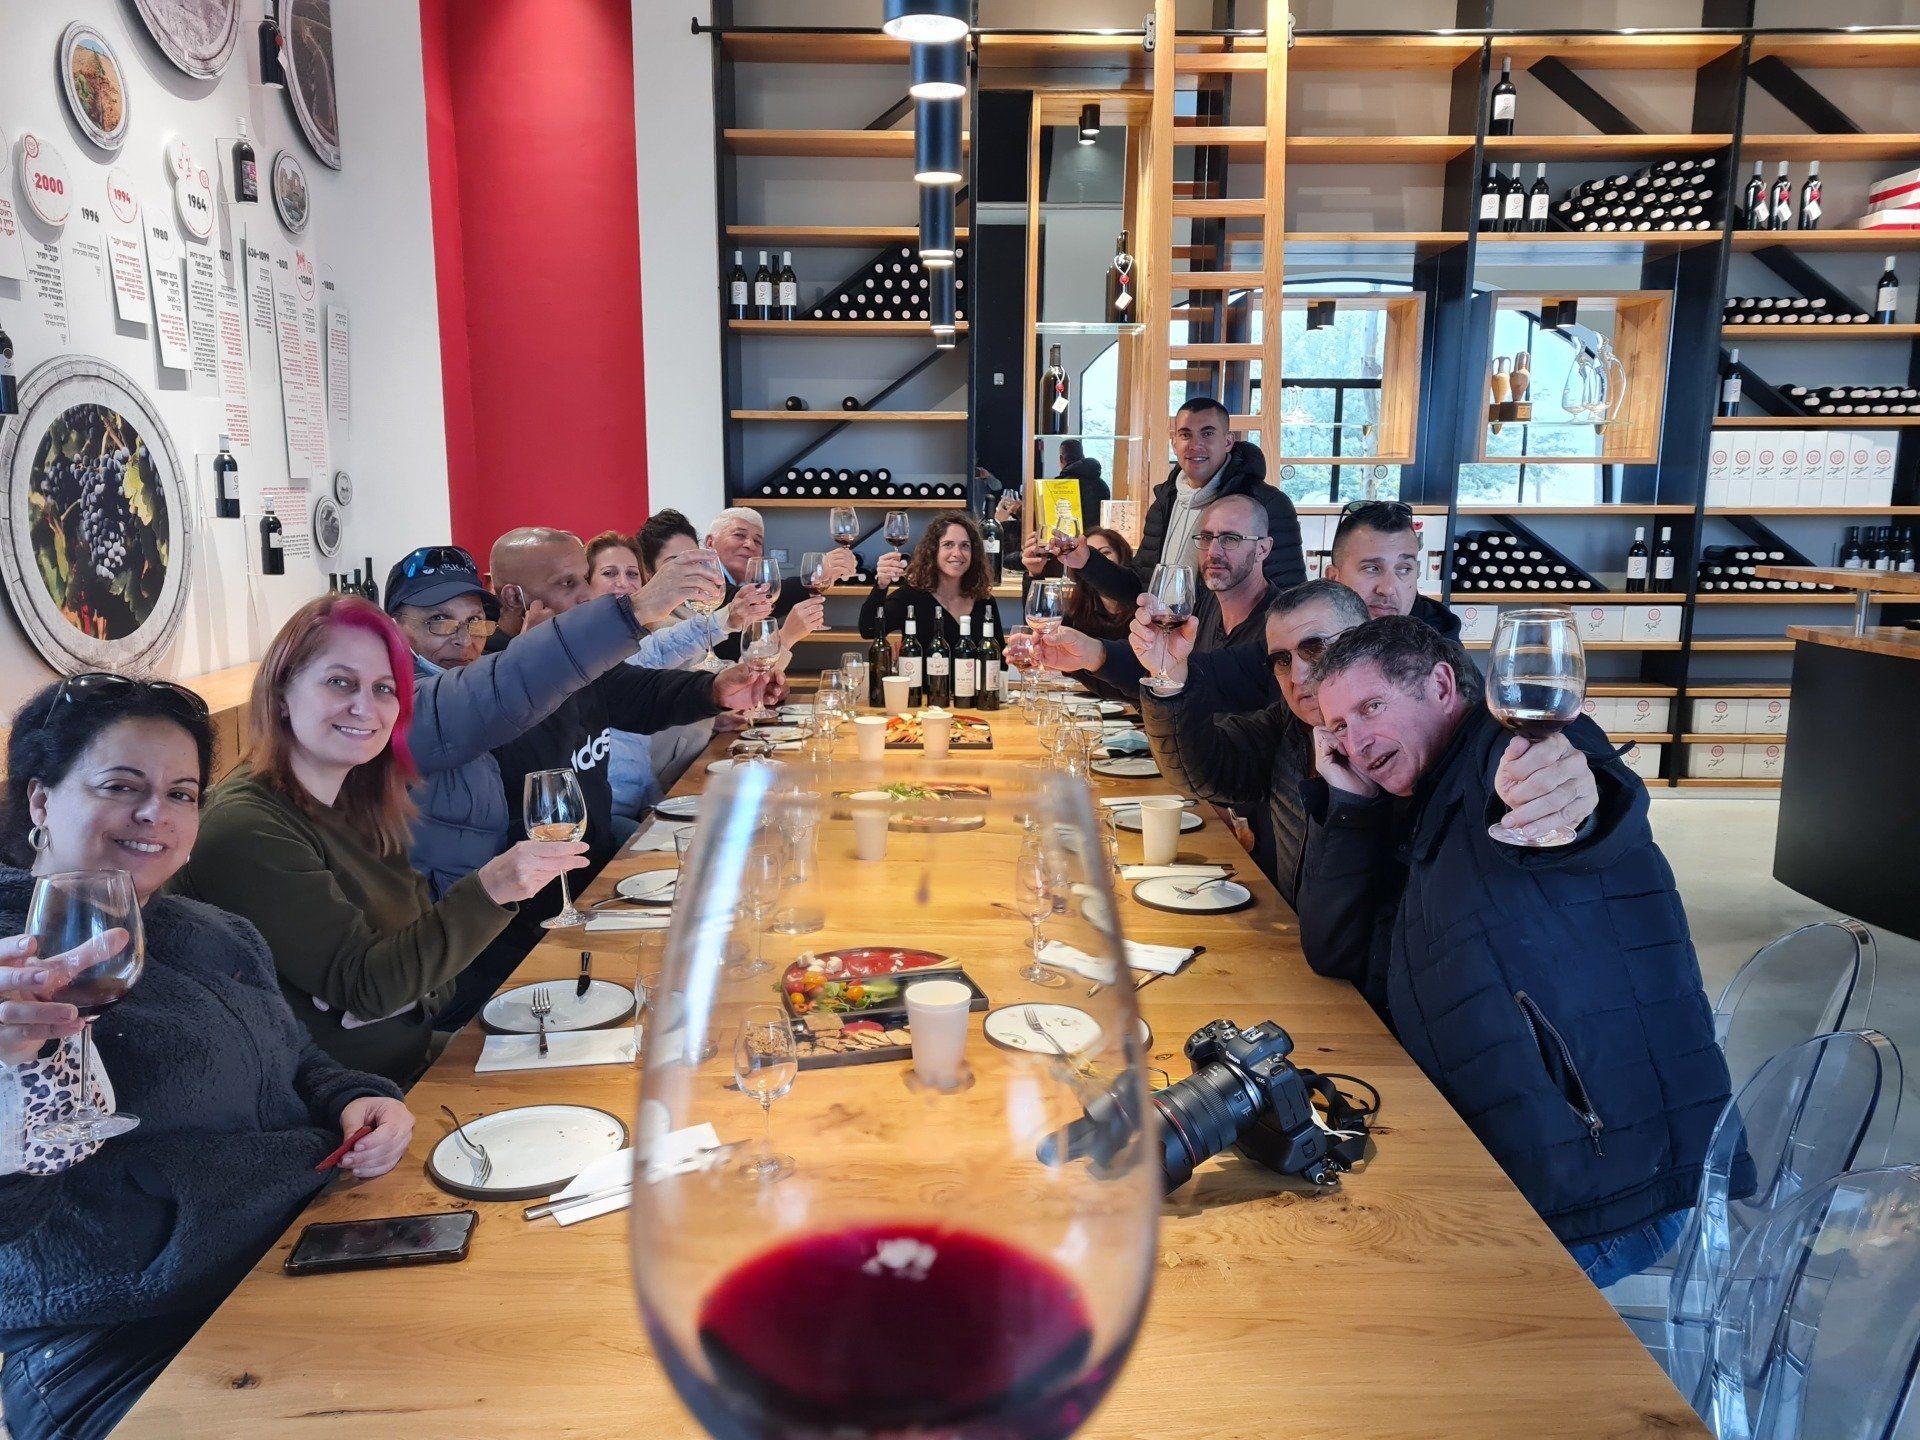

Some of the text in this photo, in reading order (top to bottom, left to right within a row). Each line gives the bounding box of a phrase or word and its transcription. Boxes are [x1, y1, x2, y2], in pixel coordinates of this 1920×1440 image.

[34, 172, 64, 195] 2000
[113, 188, 131, 204] 1994
[187, 193, 207, 212] 1964
[81, 207, 100, 223] 1996
[152, 227, 169, 241] 1980
